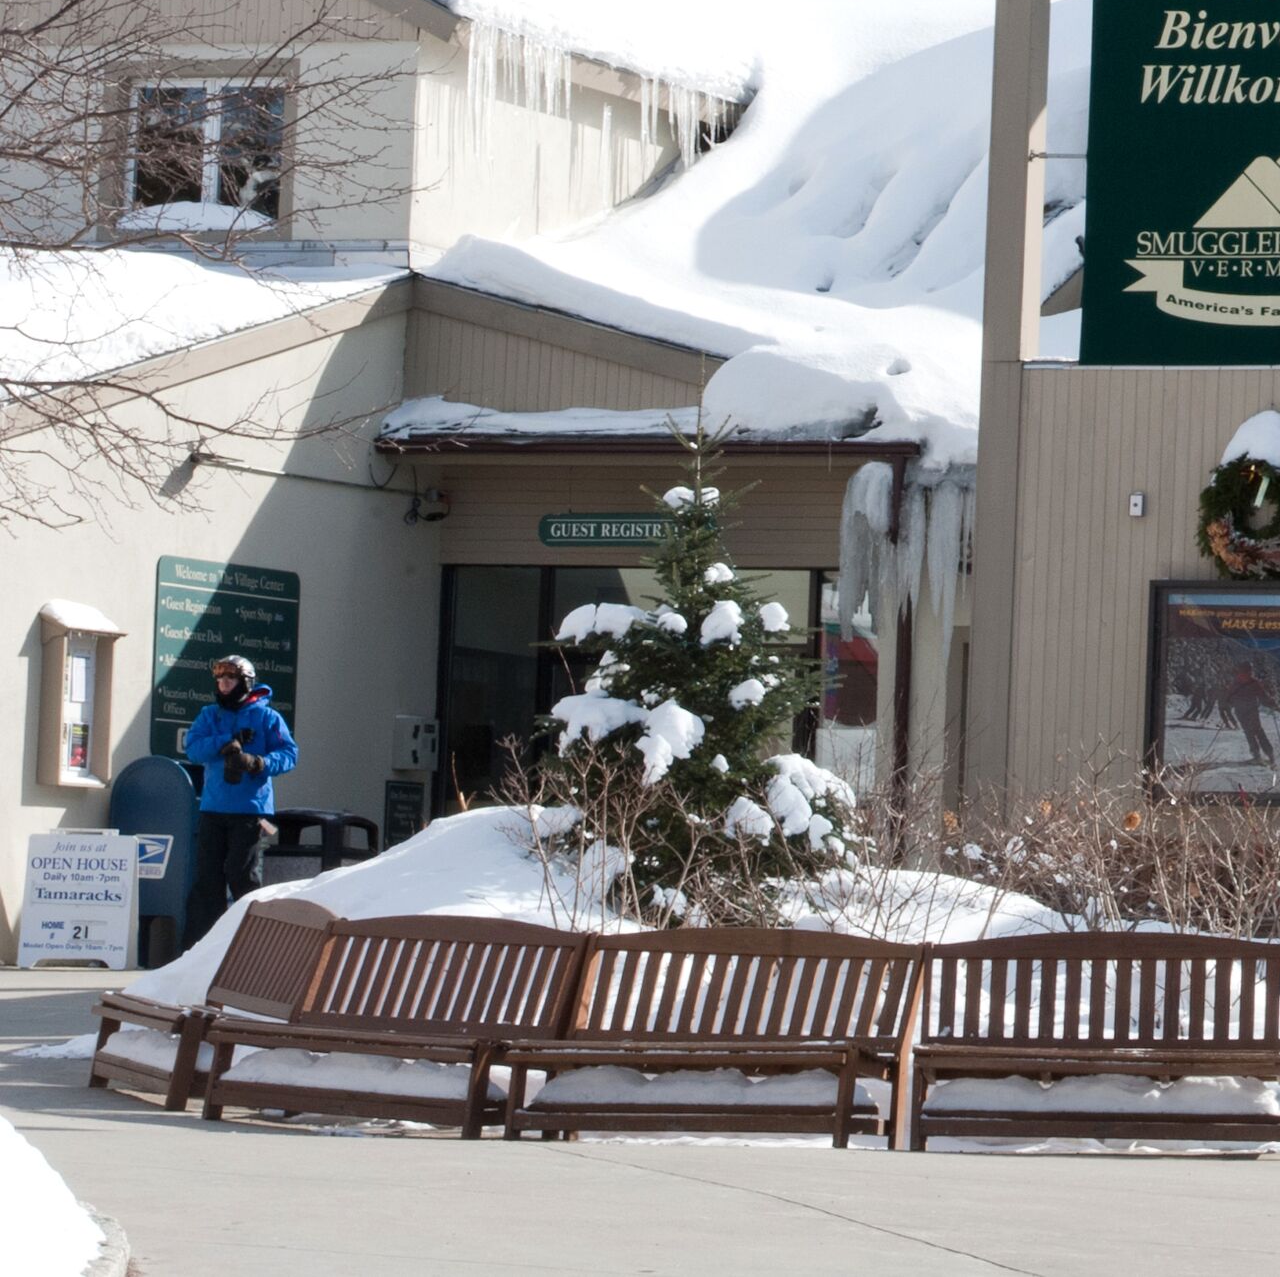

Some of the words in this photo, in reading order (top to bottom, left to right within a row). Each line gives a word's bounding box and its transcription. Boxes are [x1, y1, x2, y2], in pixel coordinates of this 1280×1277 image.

[1165, 294, 1254, 316] America's
[551, 523, 597, 537] GUEST
[175, 564, 207, 582] Welcome
[235, 573, 258, 591] Village
[260, 576, 284, 591] Center
[207, 629, 223, 643] Desk
[53, 842, 76, 854] Join
[80, 844, 92, 852] us
[96, 843, 107, 852] at
[31, 857, 72, 869] OPEN
[77, 858, 128, 871] HOUSE
[43, 873, 67, 882] Daily
[71, 874, 95, 882] 10am
[35, 888, 122, 902] Tamaracks
[42, 921, 64, 929] HOME
[73, 926, 89, 939] 21
[45, 943, 64, 951] Open
[66, 943, 82, 951] Daily
